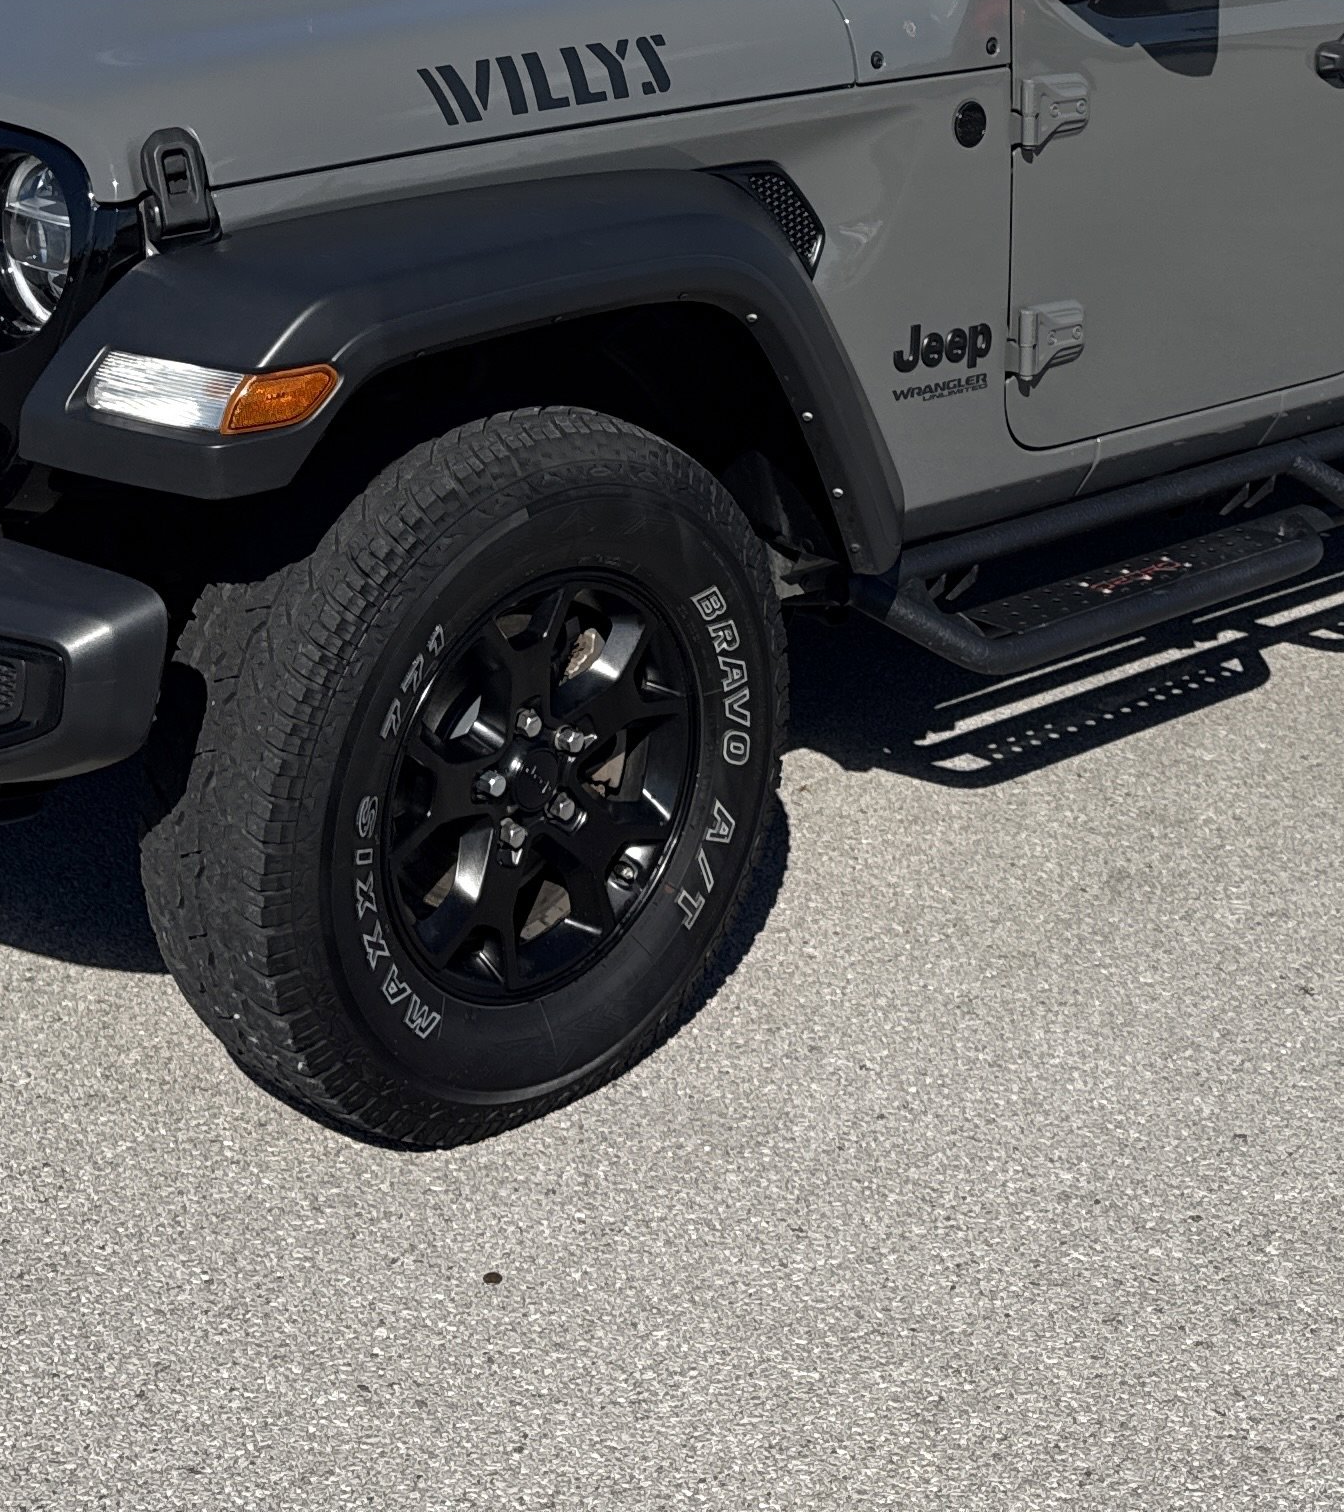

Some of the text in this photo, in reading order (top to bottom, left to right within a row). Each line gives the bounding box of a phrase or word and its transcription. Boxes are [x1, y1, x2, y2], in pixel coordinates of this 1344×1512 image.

[416, 34, 671, 126] WILLYS
[893, 323, 992, 374] Jeep
[892, 373, 987, 402] WRANGLER
[922, 383, 988, 402] UNLIMITED
[674, 585, 751, 931] BRAVO A/T
[356, 795, 442, 1040] MAXXIS
